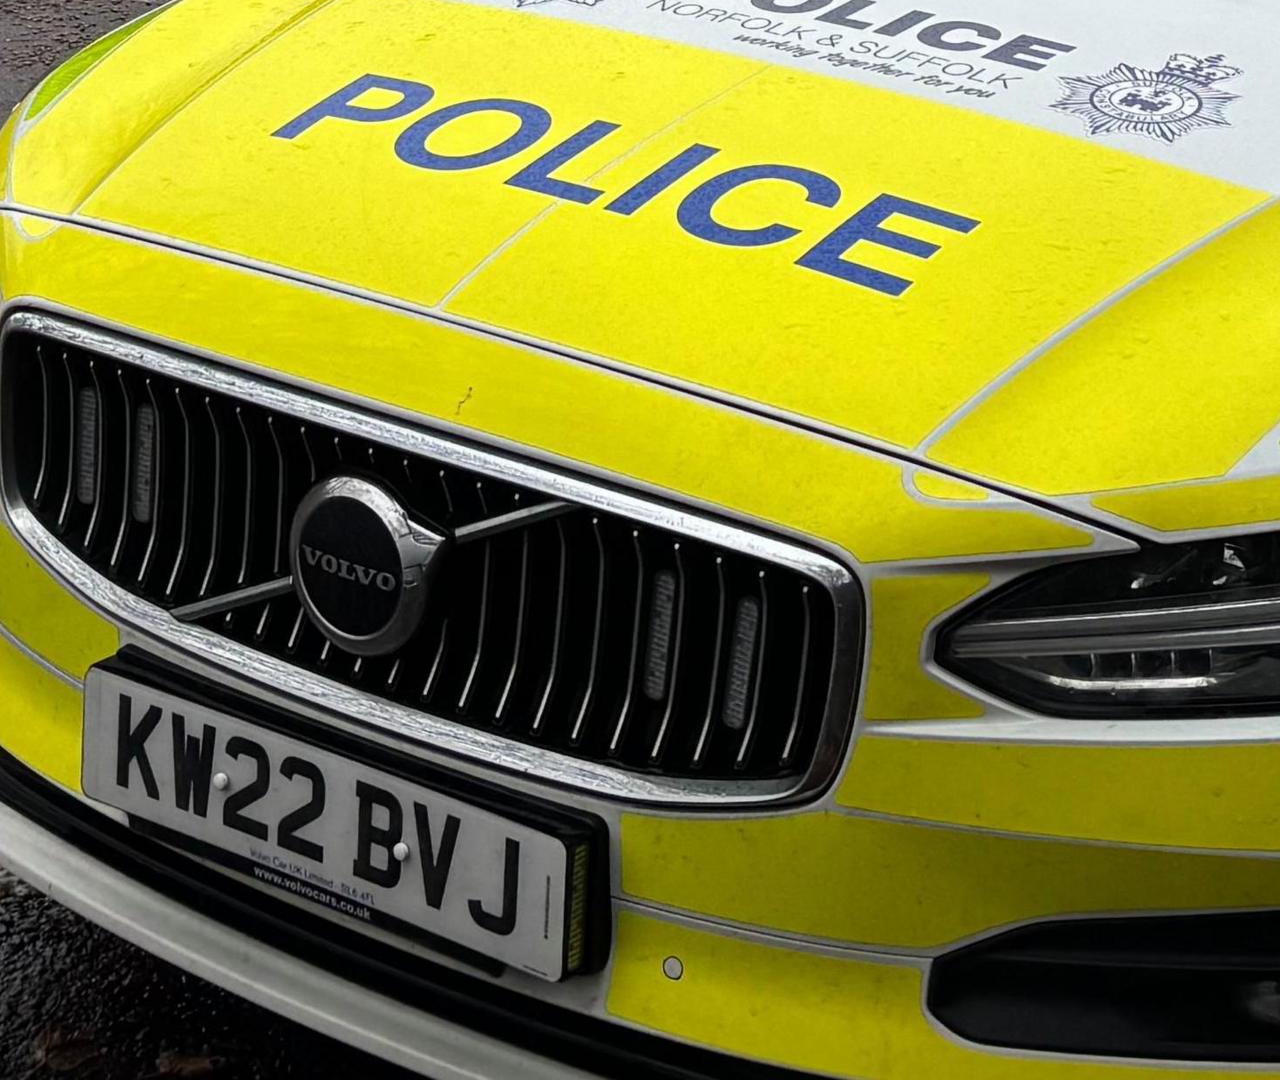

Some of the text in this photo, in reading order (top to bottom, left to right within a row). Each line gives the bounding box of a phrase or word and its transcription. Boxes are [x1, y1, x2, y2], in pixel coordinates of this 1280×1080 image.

[733, 33, 996, 101] working together for you
[816, 33, 843, 48] &
[850, 40, 1023, 89] SUFFOLK
[268, 73, 982, 296] POLICE
[302, 543, 396, 592] VOLVO
[116, 692, 326, 864] KW22
[353, 779, 520, 937] BVJ
[254, 866, 371, 920] www.volvocars.co.uk
